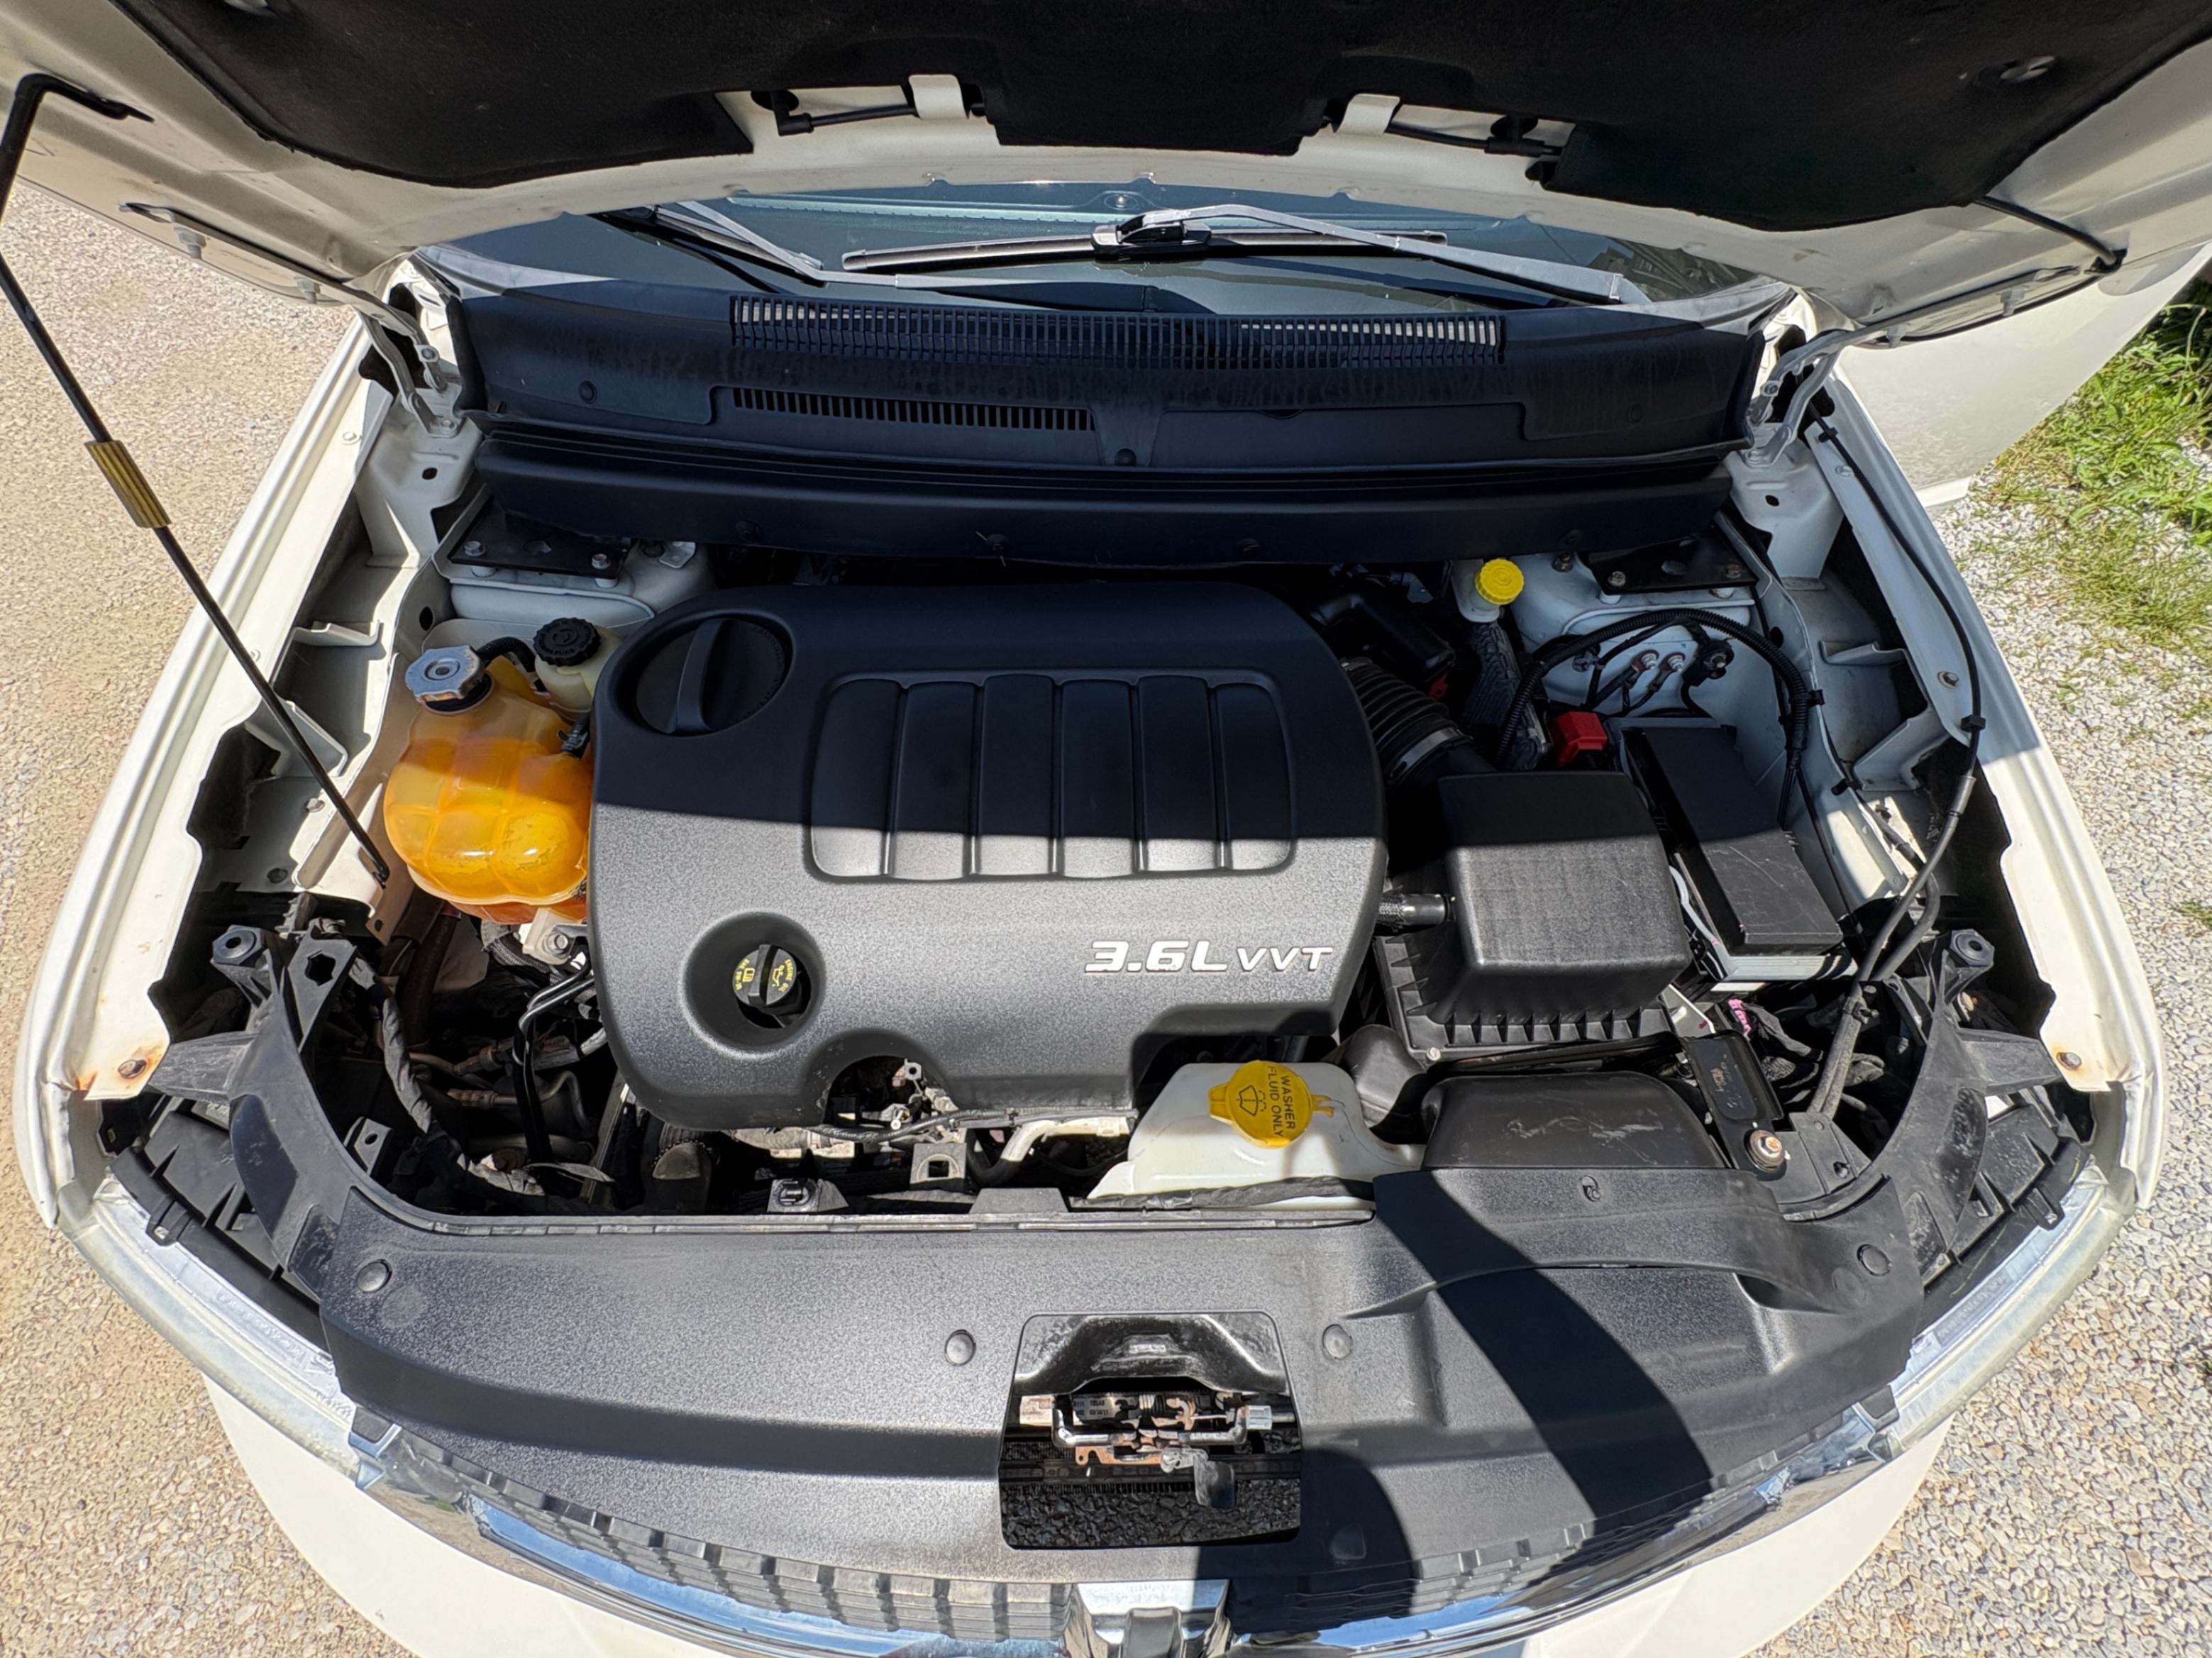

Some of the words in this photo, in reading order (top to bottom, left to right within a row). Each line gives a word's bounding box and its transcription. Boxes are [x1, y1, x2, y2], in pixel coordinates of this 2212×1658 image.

[785, 959, 793, 981] ENGINE
[1085, 940, 1227, 973] 3.6L
[1236, 946, 1334, 972] VVT
[778, 983, 788, 992] OIL
[1267, 1066, 1280, 1101] FLUID
[1280, 1075, 1296, 1130] WASHER
[1271, 1105, 1284, 1137] ONLY
